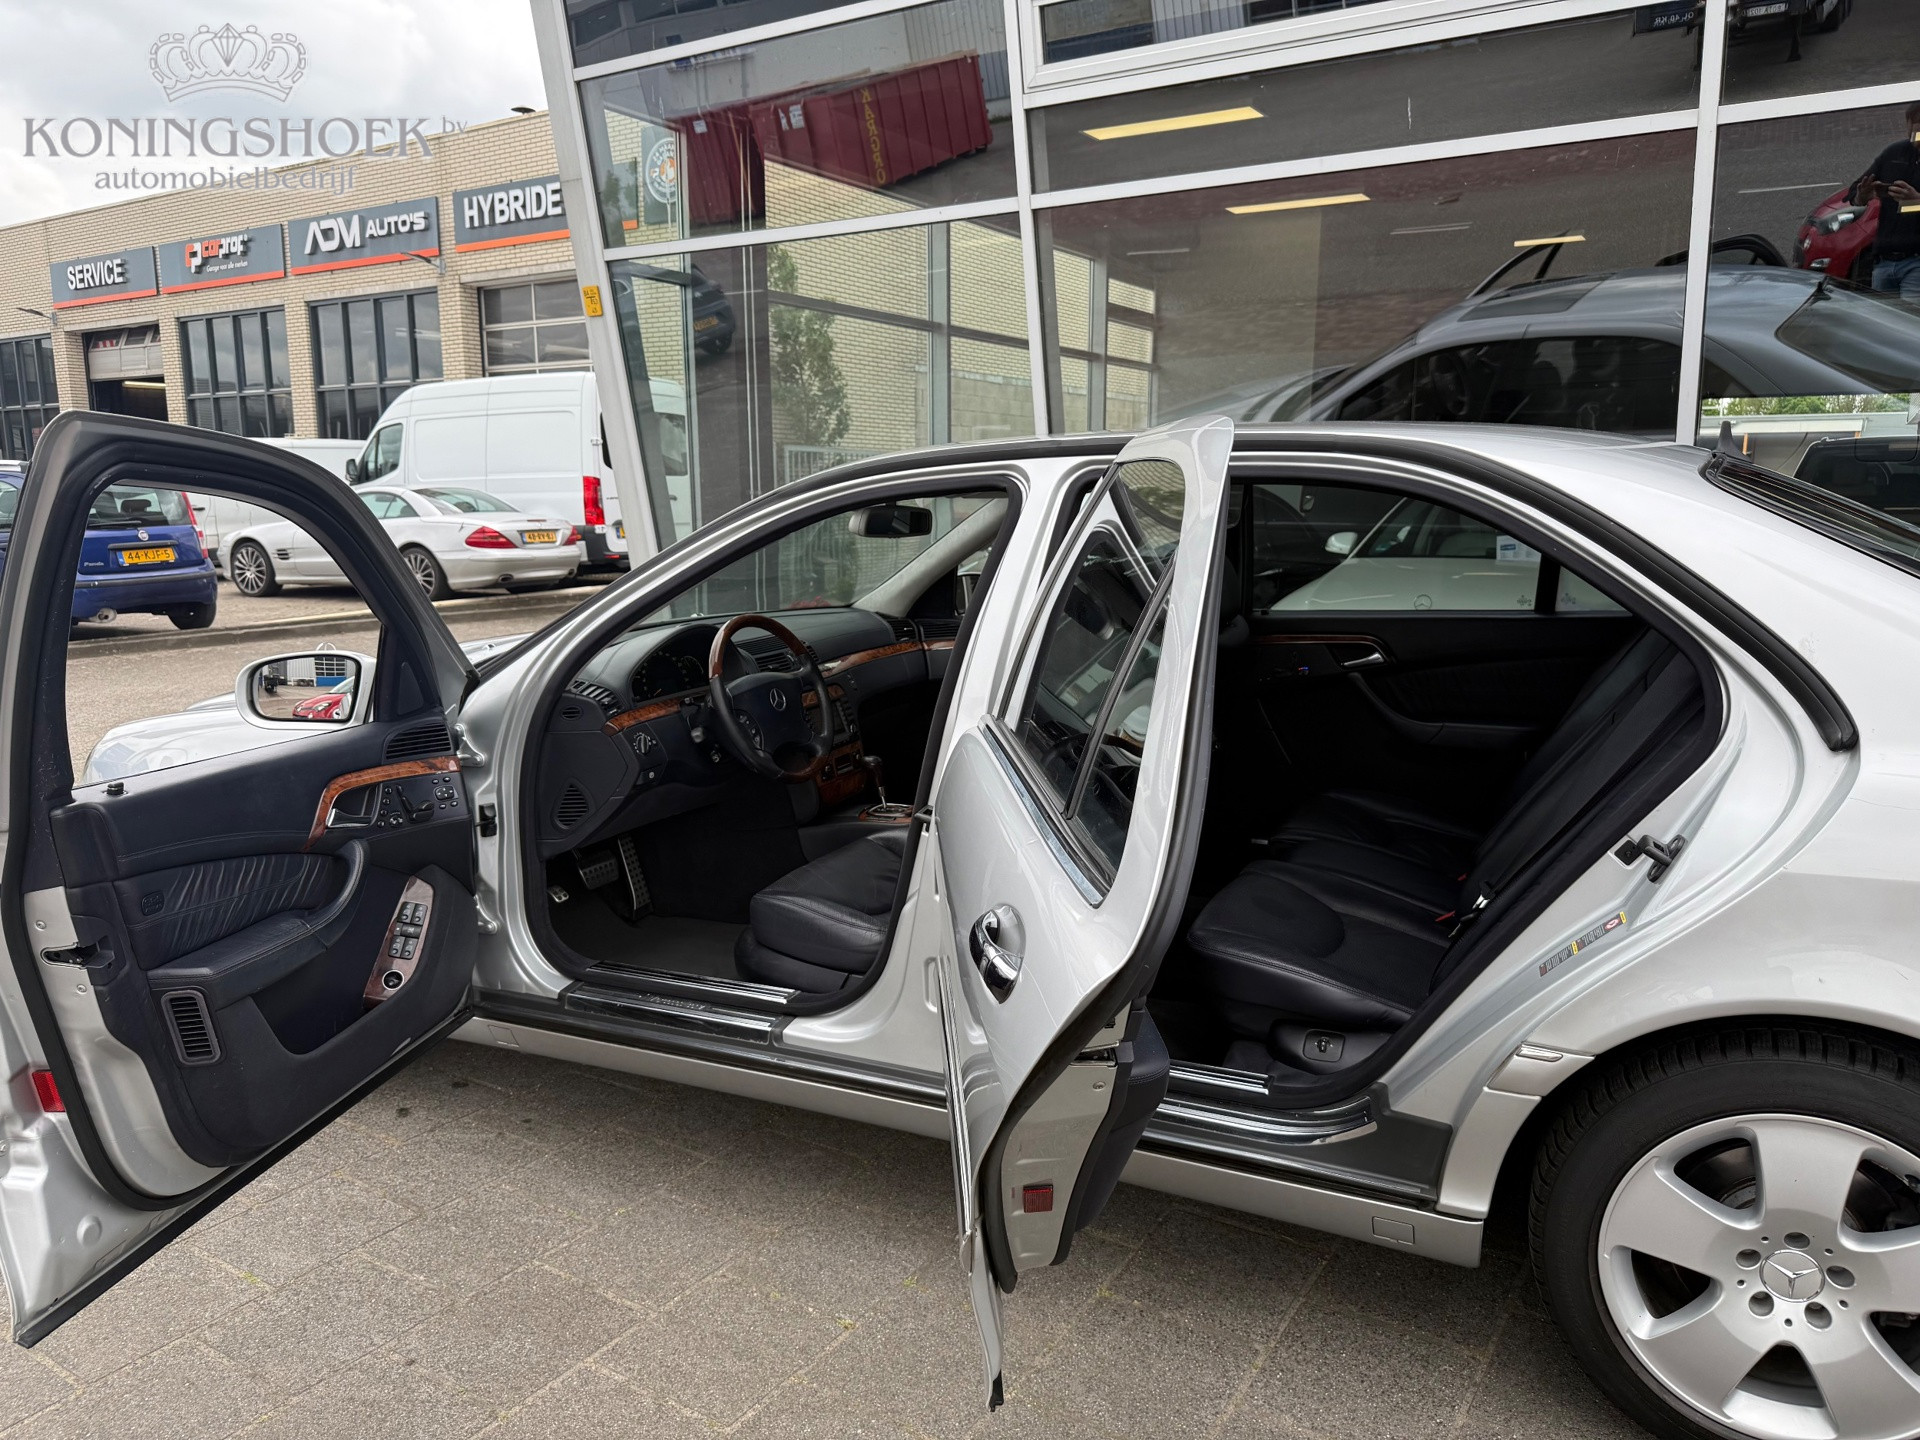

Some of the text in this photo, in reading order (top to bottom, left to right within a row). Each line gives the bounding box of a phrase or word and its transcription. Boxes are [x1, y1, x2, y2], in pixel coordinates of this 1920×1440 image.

[304, 211, 427, 255] ADM AUTO'S
[67, 258, 123, 290] SERVICE
[127, 549, 171, 561] 44-KJF-5
